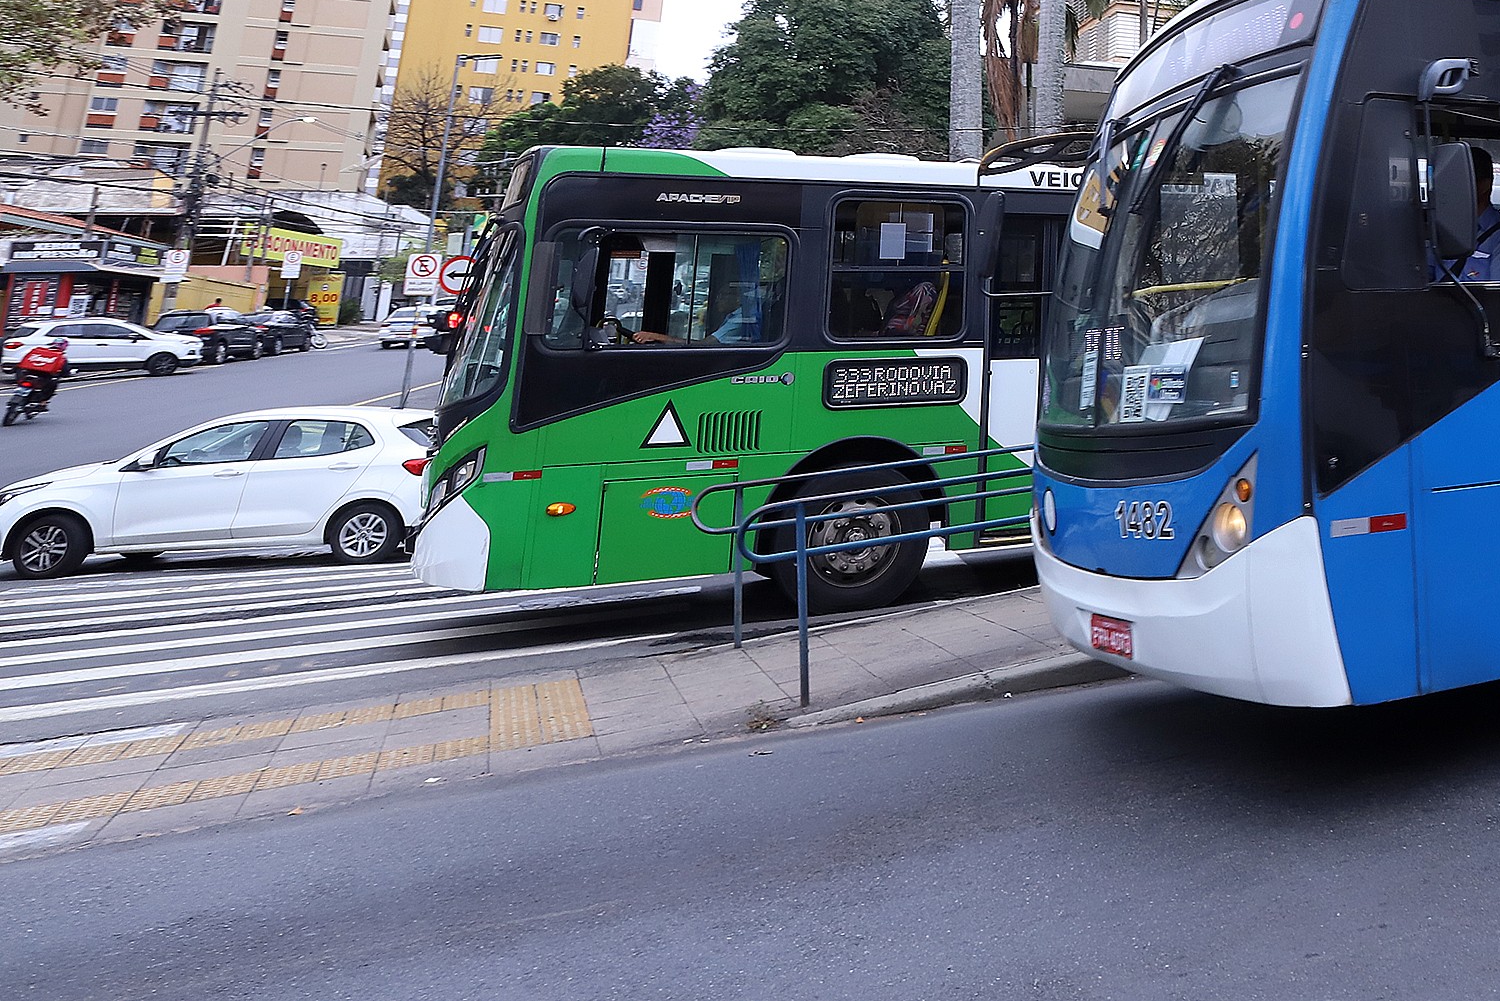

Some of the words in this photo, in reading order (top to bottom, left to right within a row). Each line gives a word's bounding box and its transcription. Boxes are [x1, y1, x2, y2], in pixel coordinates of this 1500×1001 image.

[310, 293, 338, 305] 8,00
[731, 375, 779, 385] CAIO
[835, 368, 873, 384] 333
[874, 365, 952, 382] RODOVIA
[832, 381, 921, 399] ZEFERINO
[922, 380, 957, 395] VAZ
[1115, 500, 1175, 540] 1482
